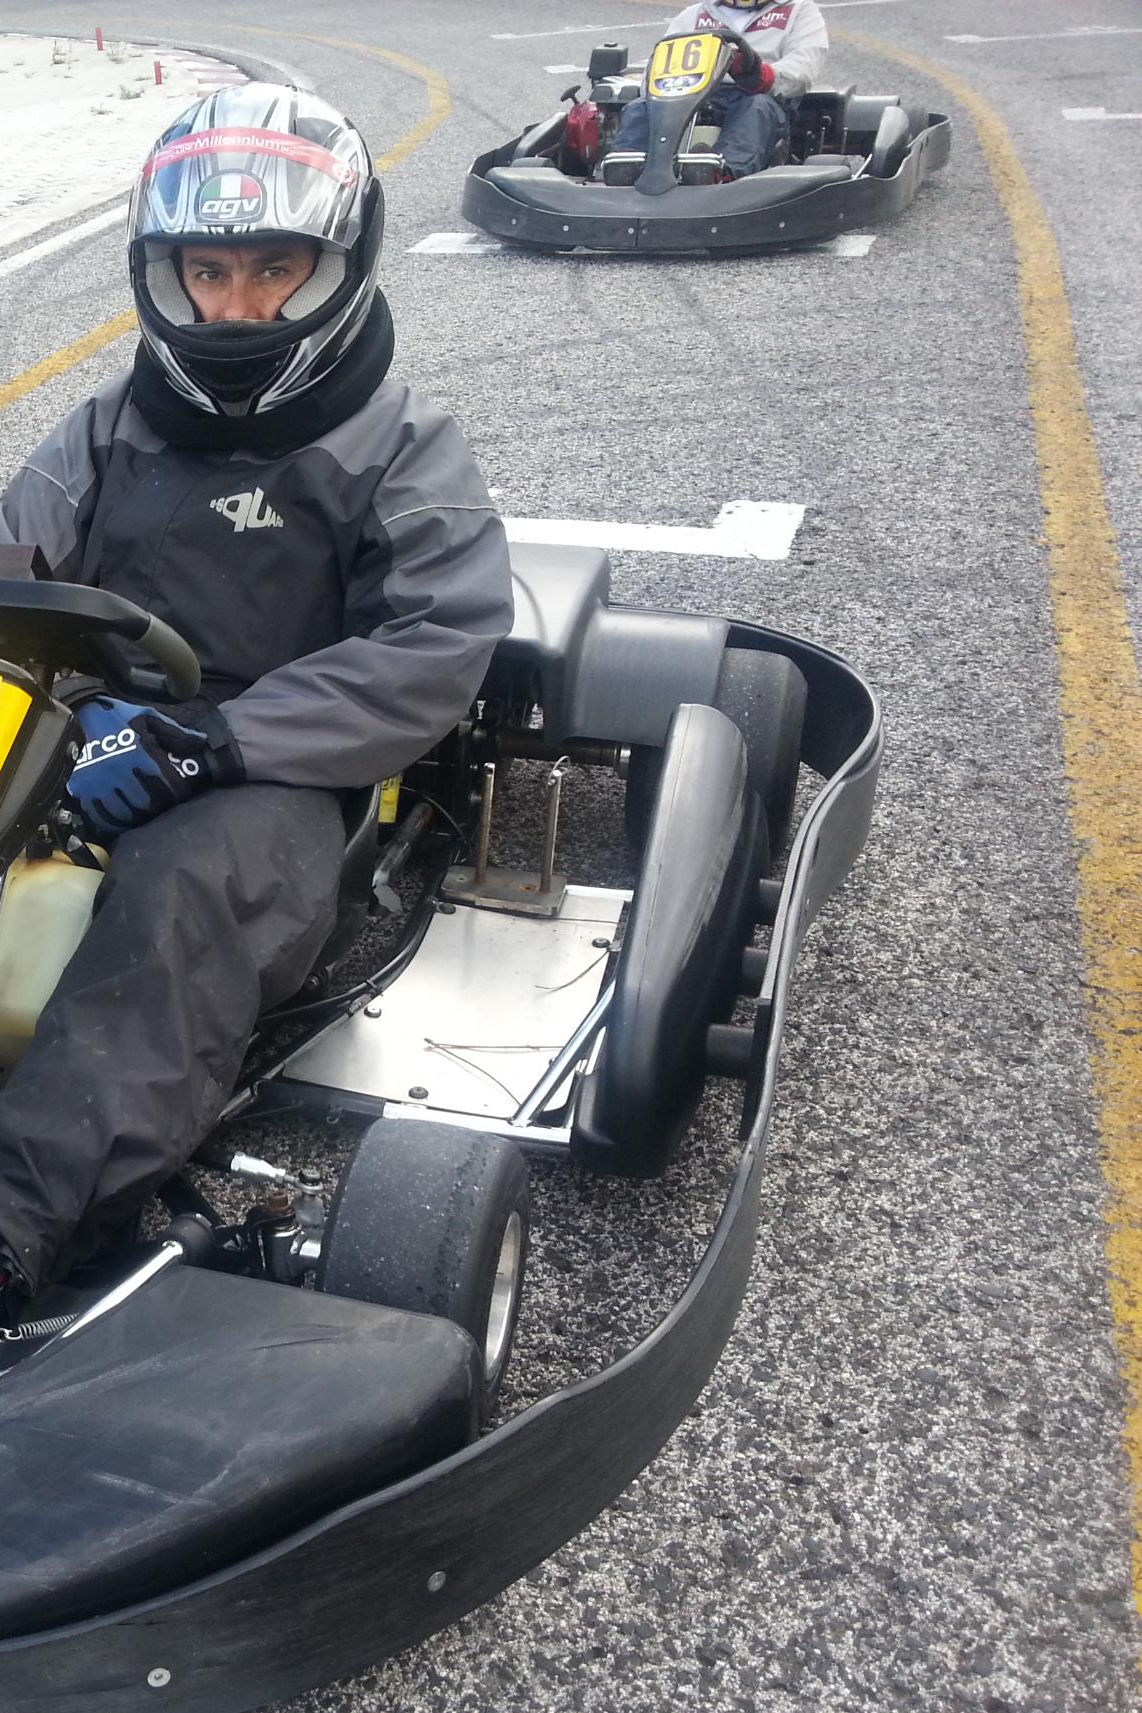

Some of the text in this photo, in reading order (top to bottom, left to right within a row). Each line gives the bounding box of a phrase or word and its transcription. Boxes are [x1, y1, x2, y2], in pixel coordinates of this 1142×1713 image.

[661, 39, 702, 75] 16
[194, 135, 280, 150] Millennium
[201, 197, 260, 219] agv
[76, 728, 136, 764] arco
